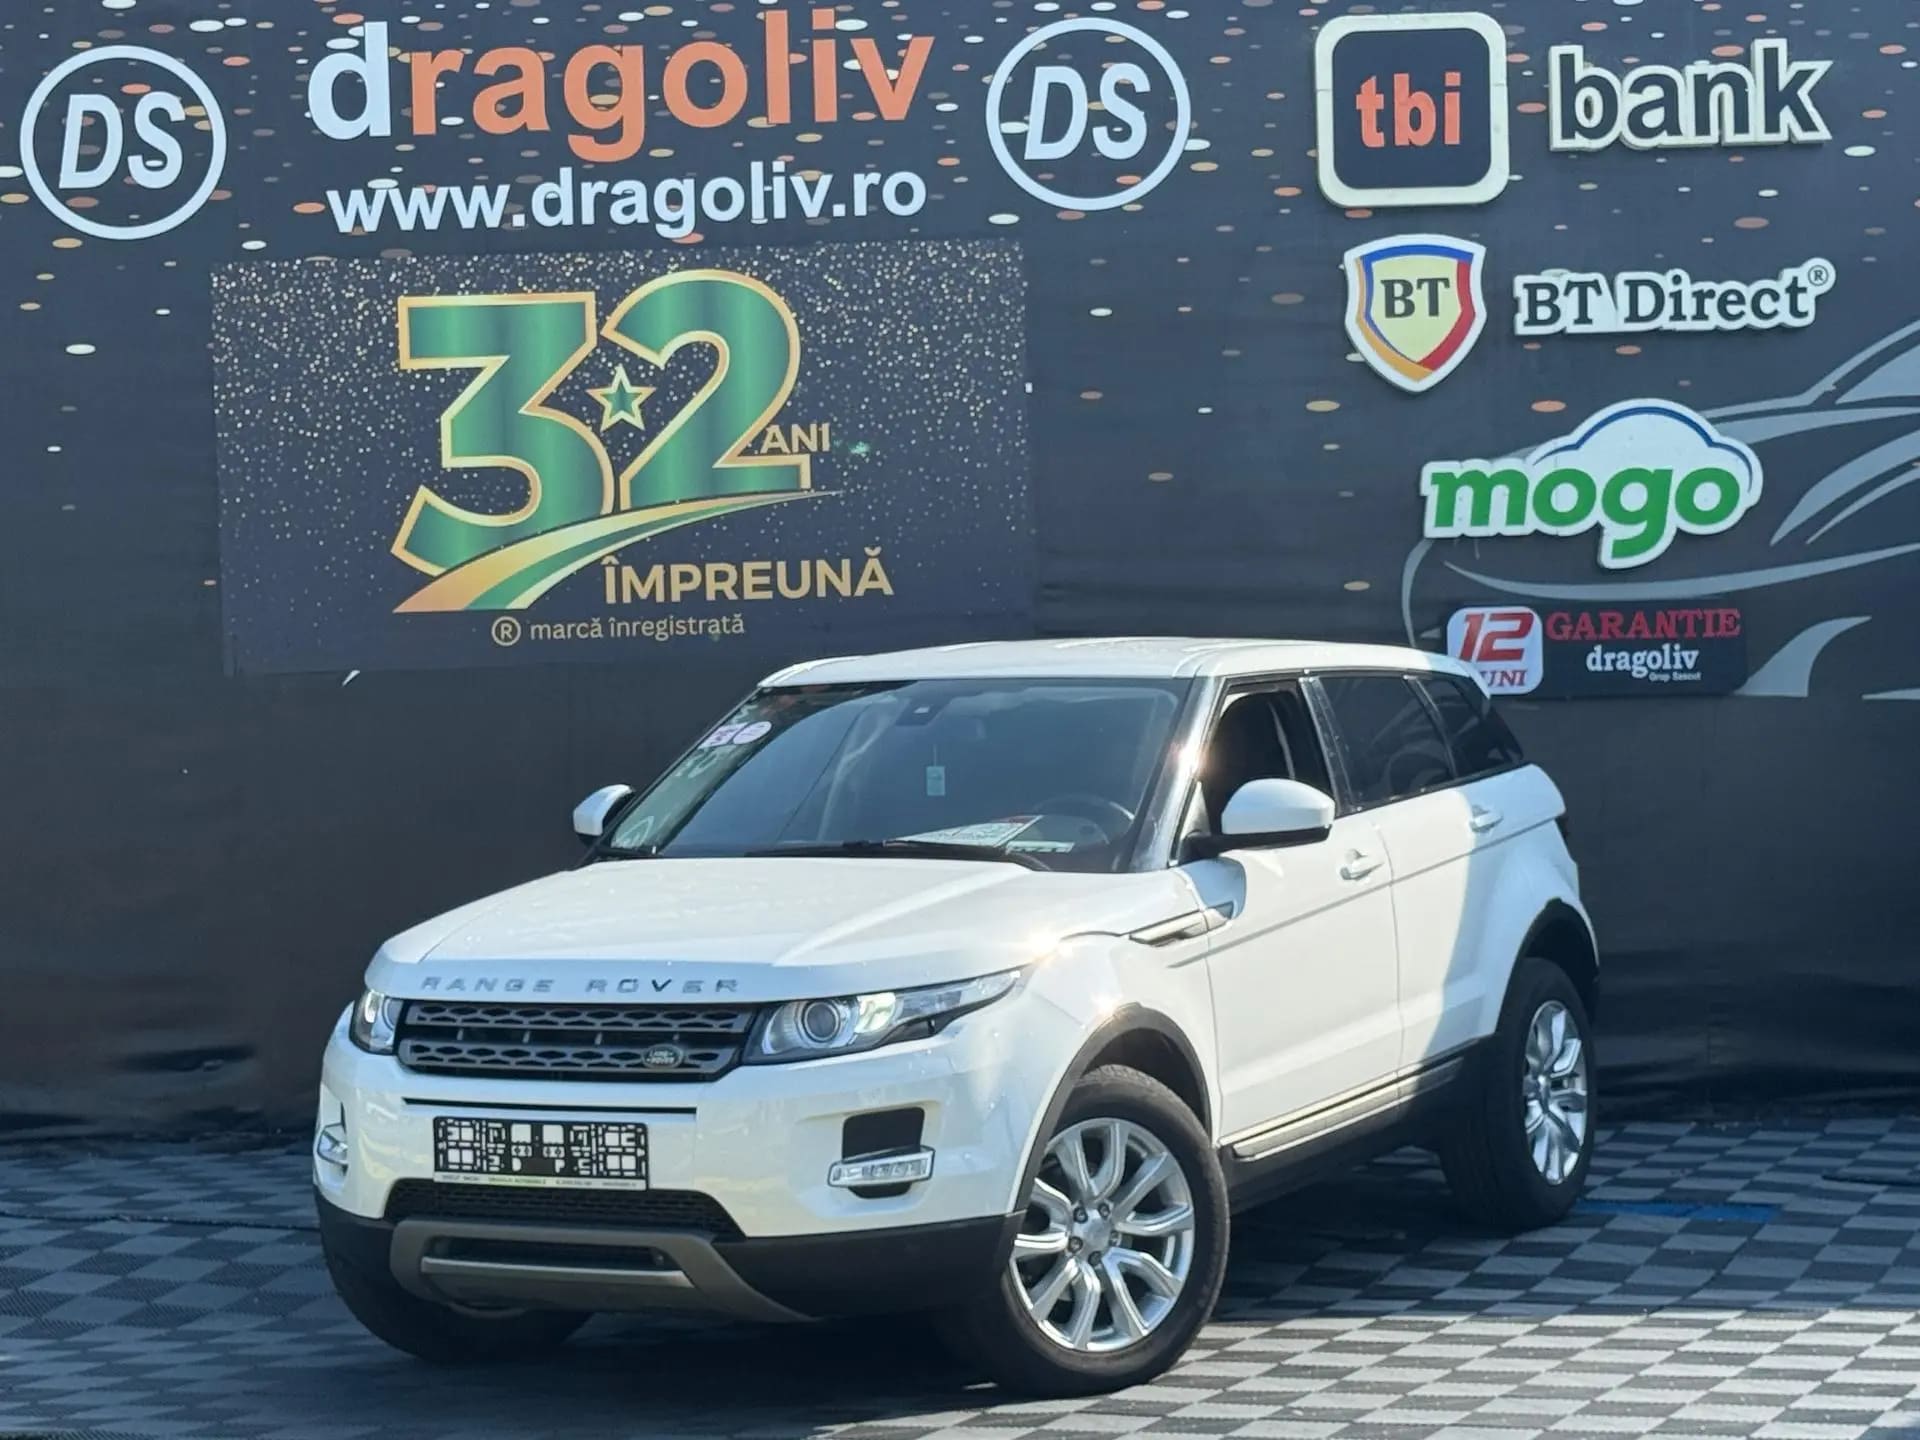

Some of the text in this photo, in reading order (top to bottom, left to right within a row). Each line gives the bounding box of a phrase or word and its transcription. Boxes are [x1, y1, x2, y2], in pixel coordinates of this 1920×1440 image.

[307, 8, 935, 163] dragoliv
[1024, 62, 1151, 160] DS
[1355, 71, 1461, 148] tbi
[1559, 43, 1825, 142] bank
[59, 91, 186, 189] DS
[326, 160, 927, 239] www.dragoliv.ro
[1380, 277, 1450, 319] BT
[1522, 281, 1604, 327] BT
[390, 269, 812, 577] 32
[760, 423, 831, 454] ANI
[1430, 467, 1740, 559] mogo
[601, 547, 894, 604] ÎMPREUNĂ
[530, 617, 603, 640] marcă
[608, 613, 745, 642] înregistrată
[1458, 612, 1534, 662] 12
[1545, 608, 1741, 641] GARANTIE
[1480, 669, 1527, 687] UNI
[1586, 643, 1699, 679] dragoliv
[420, 976, 738, 994] RANGE ROVER
